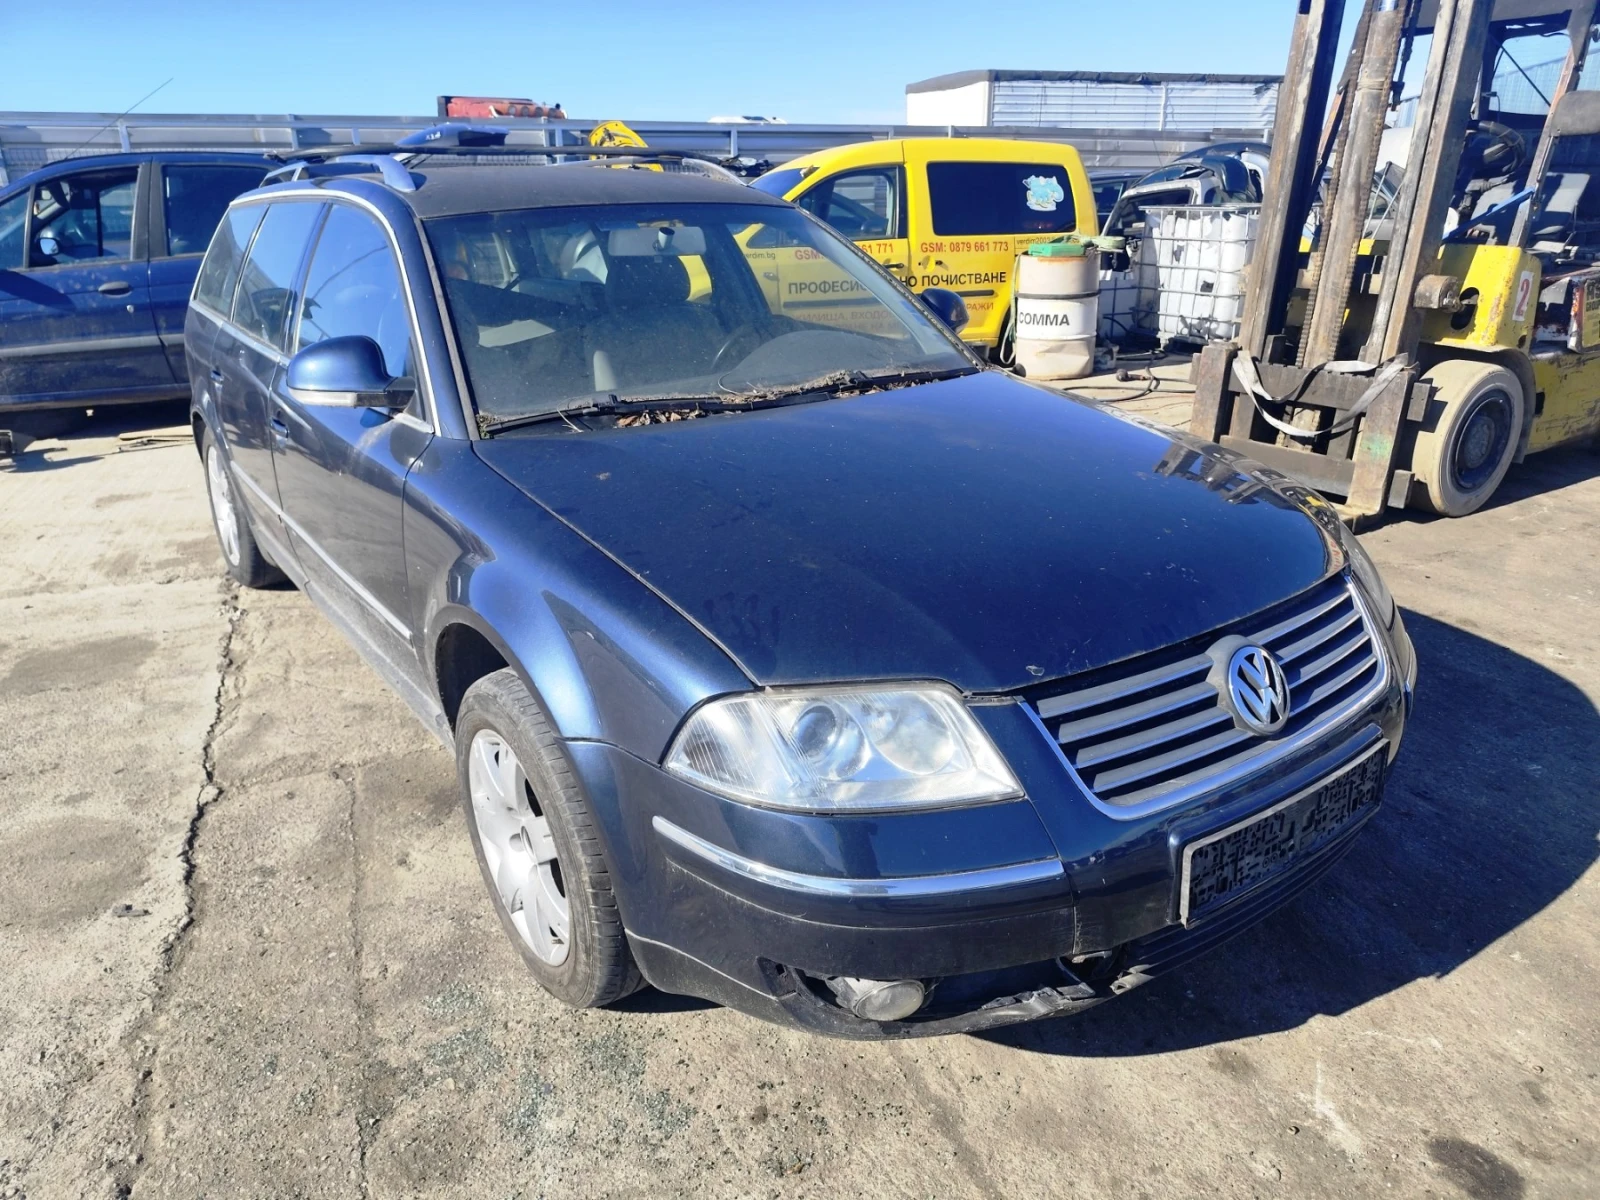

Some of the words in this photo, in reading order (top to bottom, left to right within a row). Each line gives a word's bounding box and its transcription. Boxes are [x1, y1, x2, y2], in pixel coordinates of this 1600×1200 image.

[876, 242, 894, 254] 771
[920, 242, 947, 253] GSM:
[949, 241, 972, 252] 0879
[974, 241, 990, 252] 661
[993, 241, 1009, 251] 773
[921, 271, 1007, 287] ПОЧИСТВАНЕ
[1515, 278, 1531, 317] 2
[851, 310, 890, 320] ВХОДО
[966, 302, 994, 311] РАЖИ
[1019, 311, 1070, 326] COMMA
